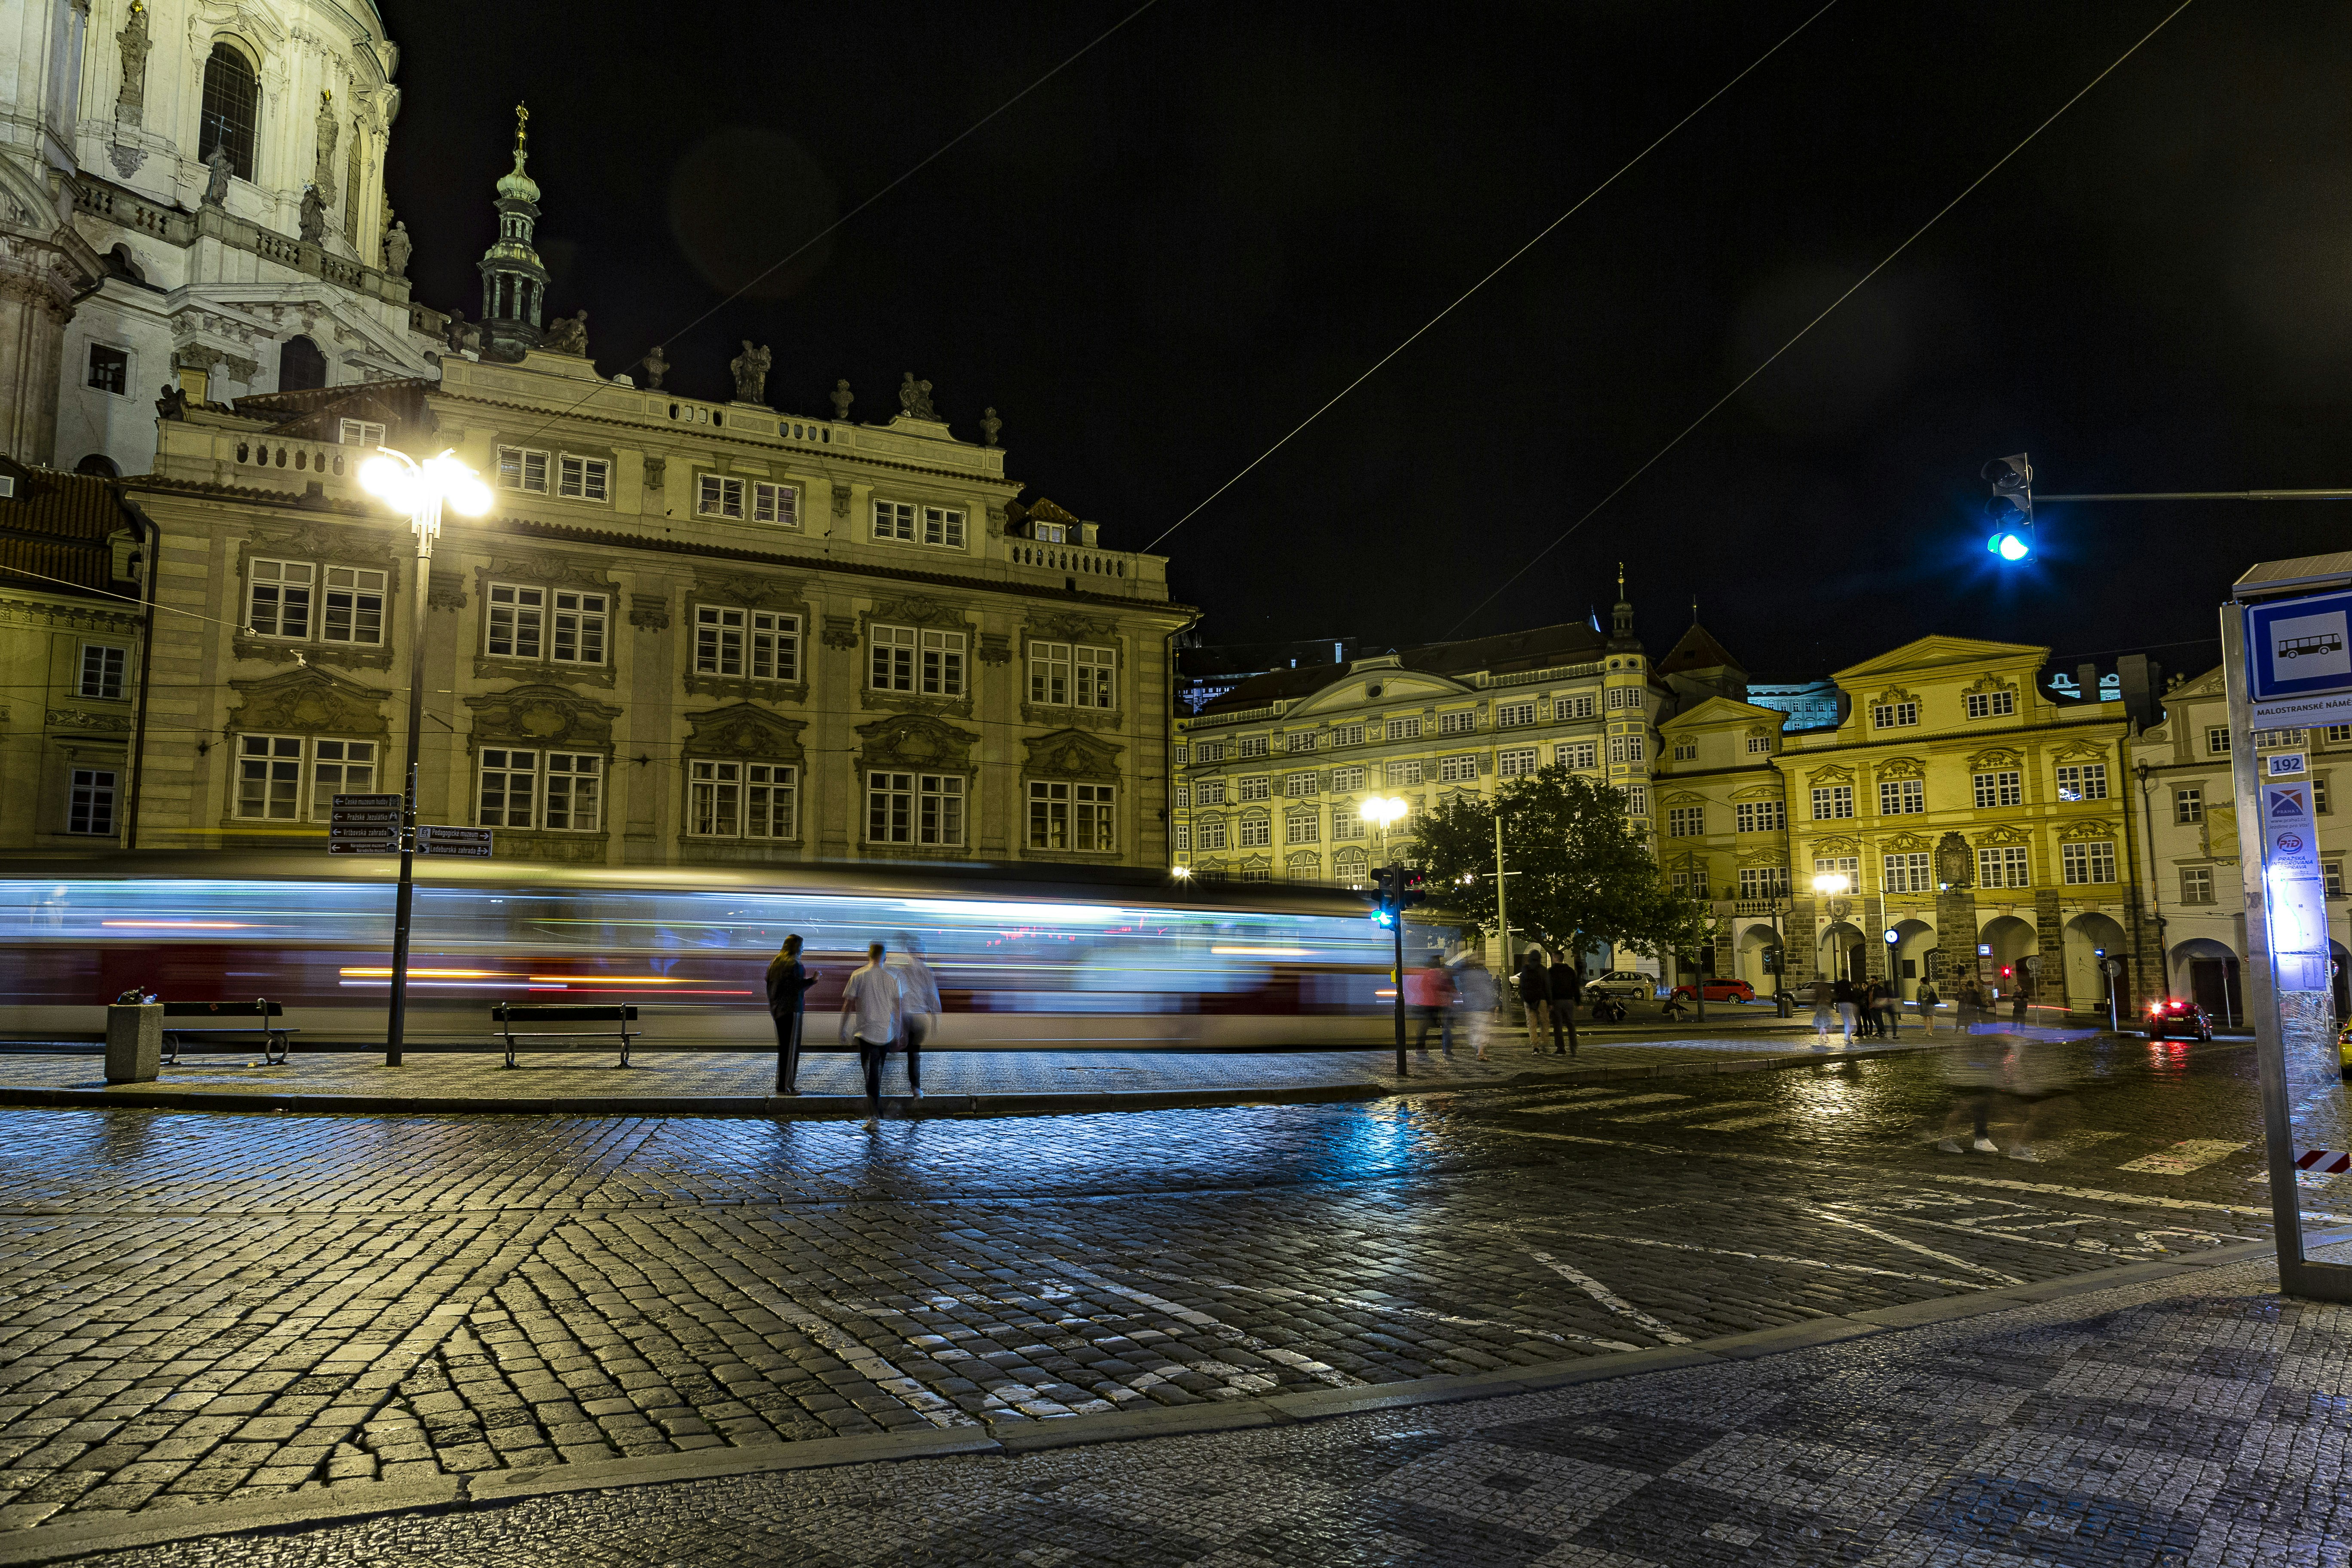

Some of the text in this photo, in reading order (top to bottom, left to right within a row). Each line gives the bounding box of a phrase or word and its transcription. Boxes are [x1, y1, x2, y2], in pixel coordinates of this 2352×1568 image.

[2257, 698, 2352, 716] MALOSTRANSKÉ NÁMĚ
[2273, 758, 2300, 772] 192
[376, 798, 388, 806] hudby
[432, 828, 459, 837] Pedagogické
